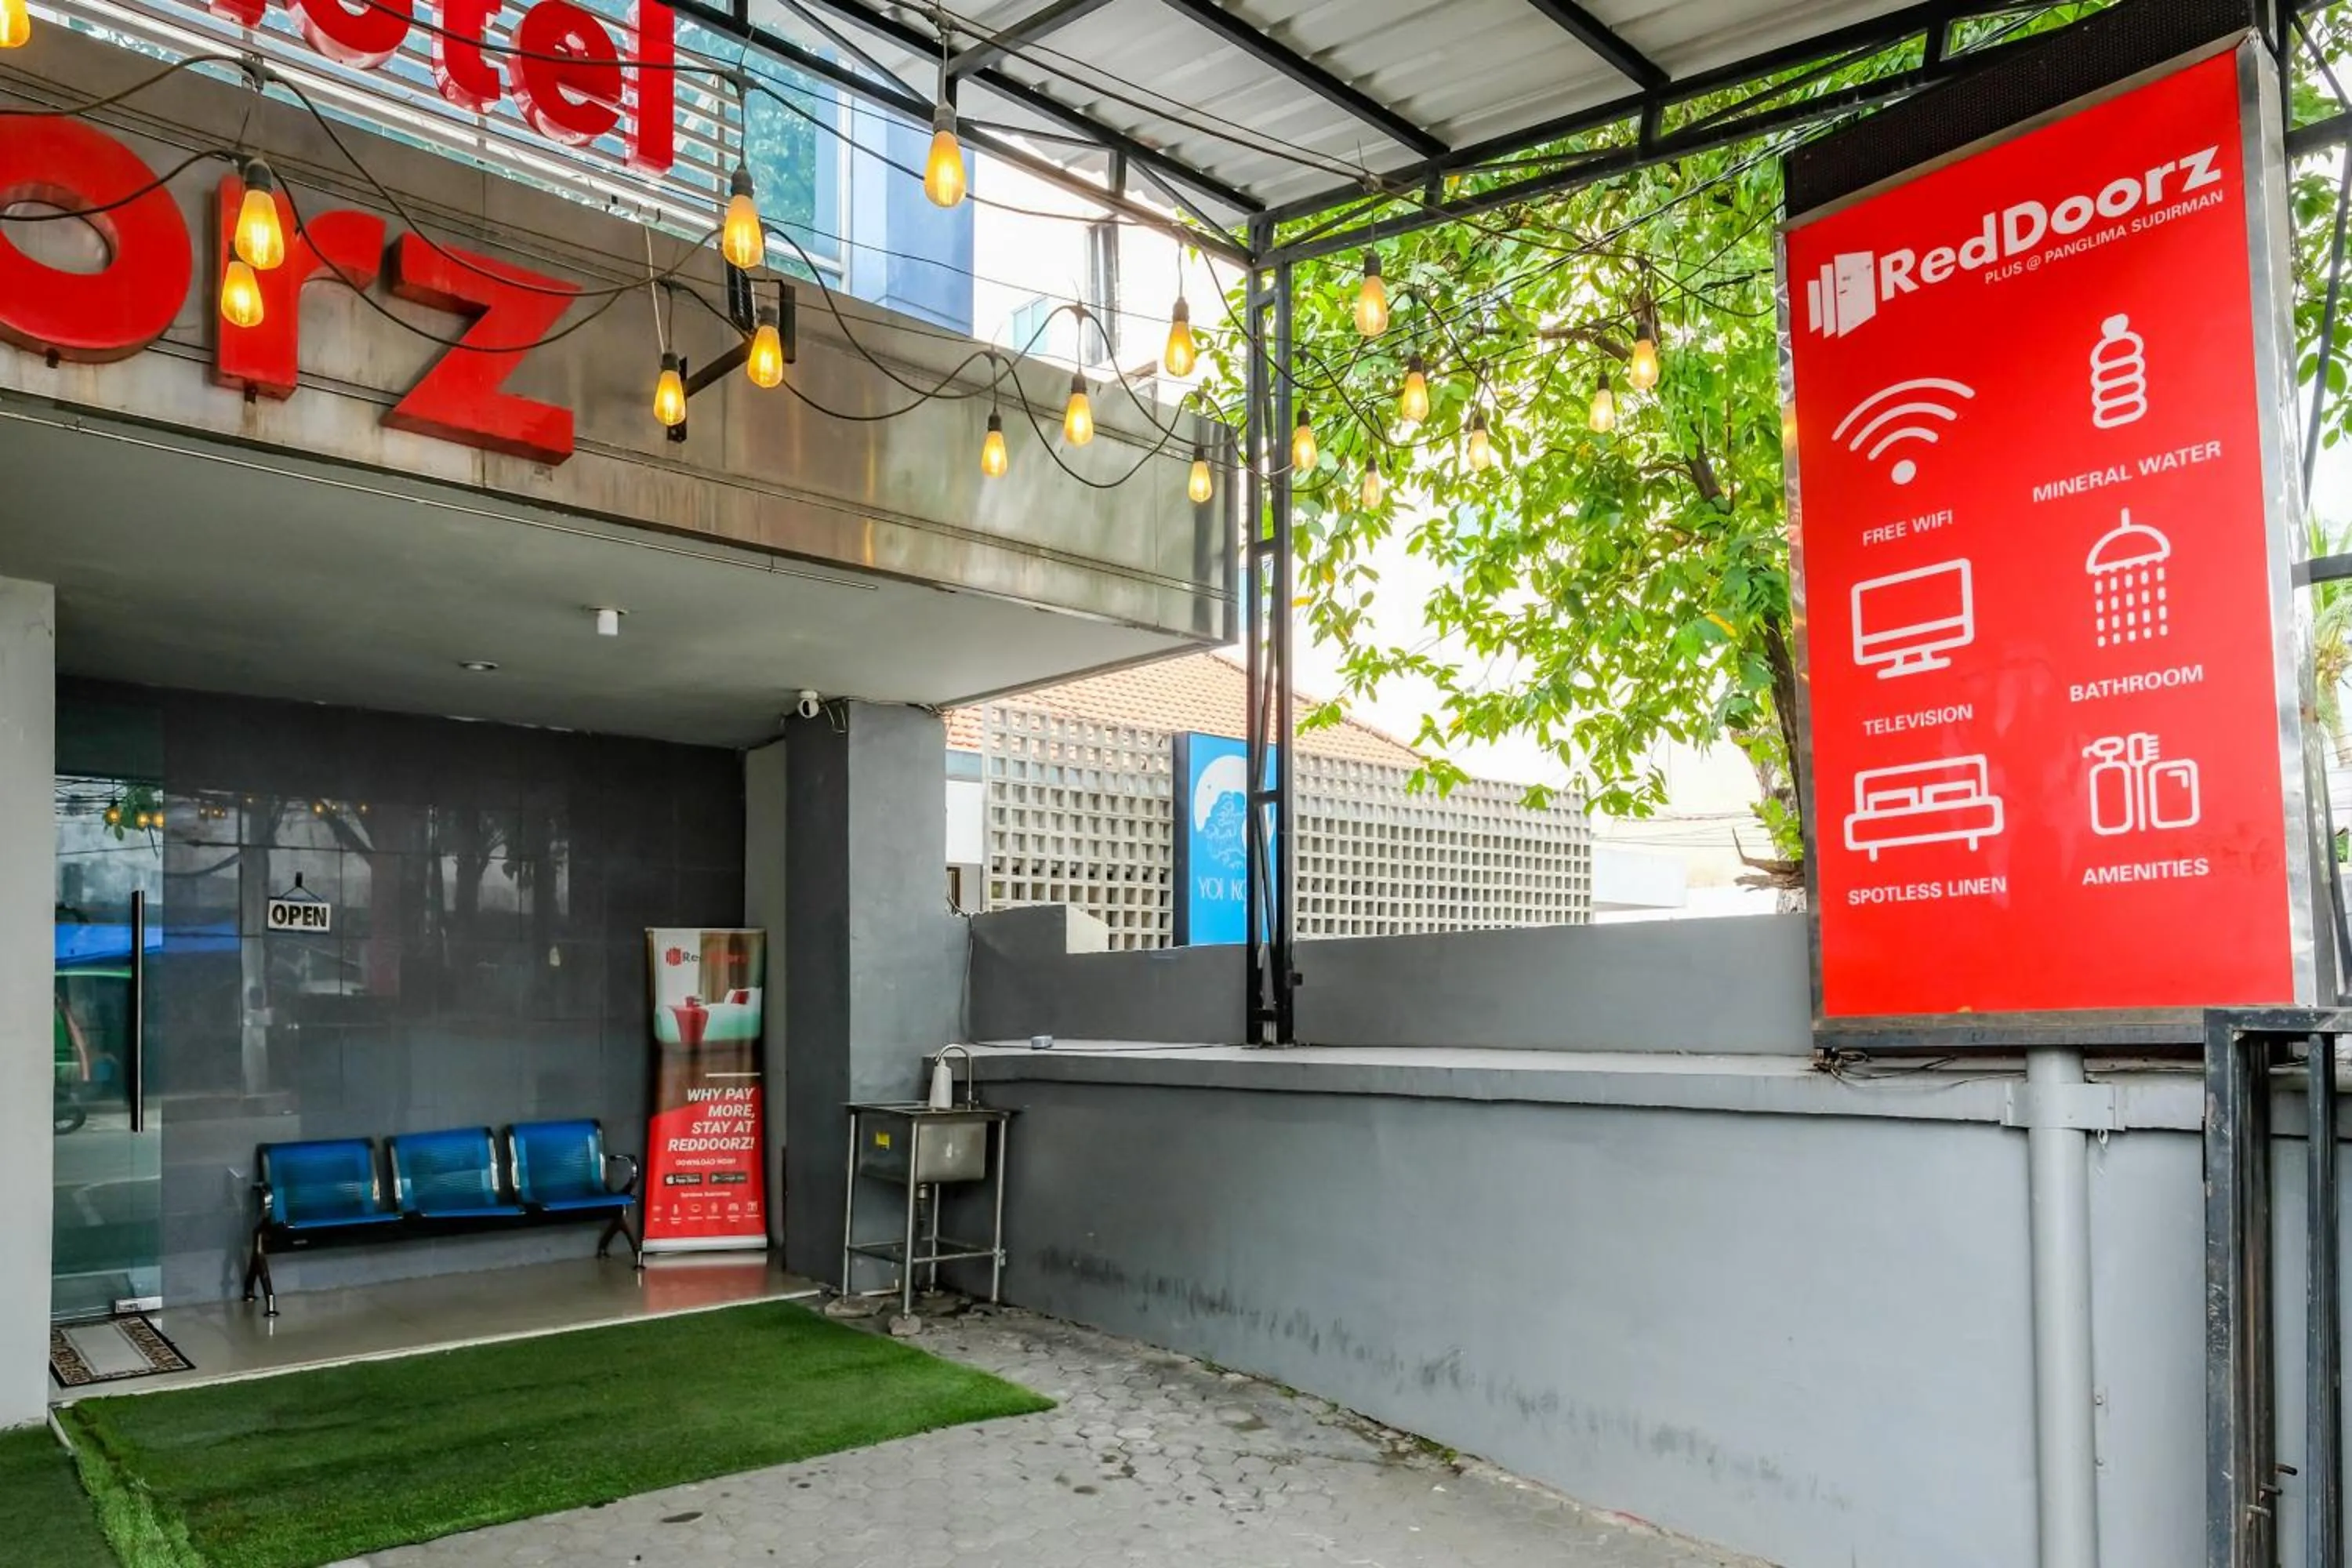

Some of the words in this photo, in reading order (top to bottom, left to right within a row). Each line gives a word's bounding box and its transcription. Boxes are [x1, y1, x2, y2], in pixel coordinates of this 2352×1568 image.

[209, 0, 675, 177] tel
[1880, 145, 2222, 302] RedDoorz
[1985, 261, 2023, 285] PLUS
[2027, 255, 2042, 271] @
[2044, 226, 2127, 263] PANGLIMA
[2131, 189, 2223, 233] SUDIRMAN
[2032, 465, 2132, 503] MINERAL
[2138, 441, 2221, 477] WATER
[1863, 519, 1907, 546] FREE
[1912, 509, 1953, 535] WIFI
[2069, 664, 2204, 702] BATHROOM
[1863, 703, 1973, 736] TELEVISION
[2082, 858, 2209, 886] AMENITIES
[1197, 877, 1223, 901] YOI
[1847, 881, 1942, 906] SPOTLESS
[1947, 876, 2007, 897] LINEN
[272, 904, 327, 927] OPEN
[687, 1088, 721, 1102] WHY
[725, 1087, 754, 1101] PAY
[708, 1104, 754, 1119] MORE,
[691, 1121, 731, 1134] STAY
[734, 1120, 754, 1133] AT
[667, 1137, 754, 1152] REDDOORZ!
